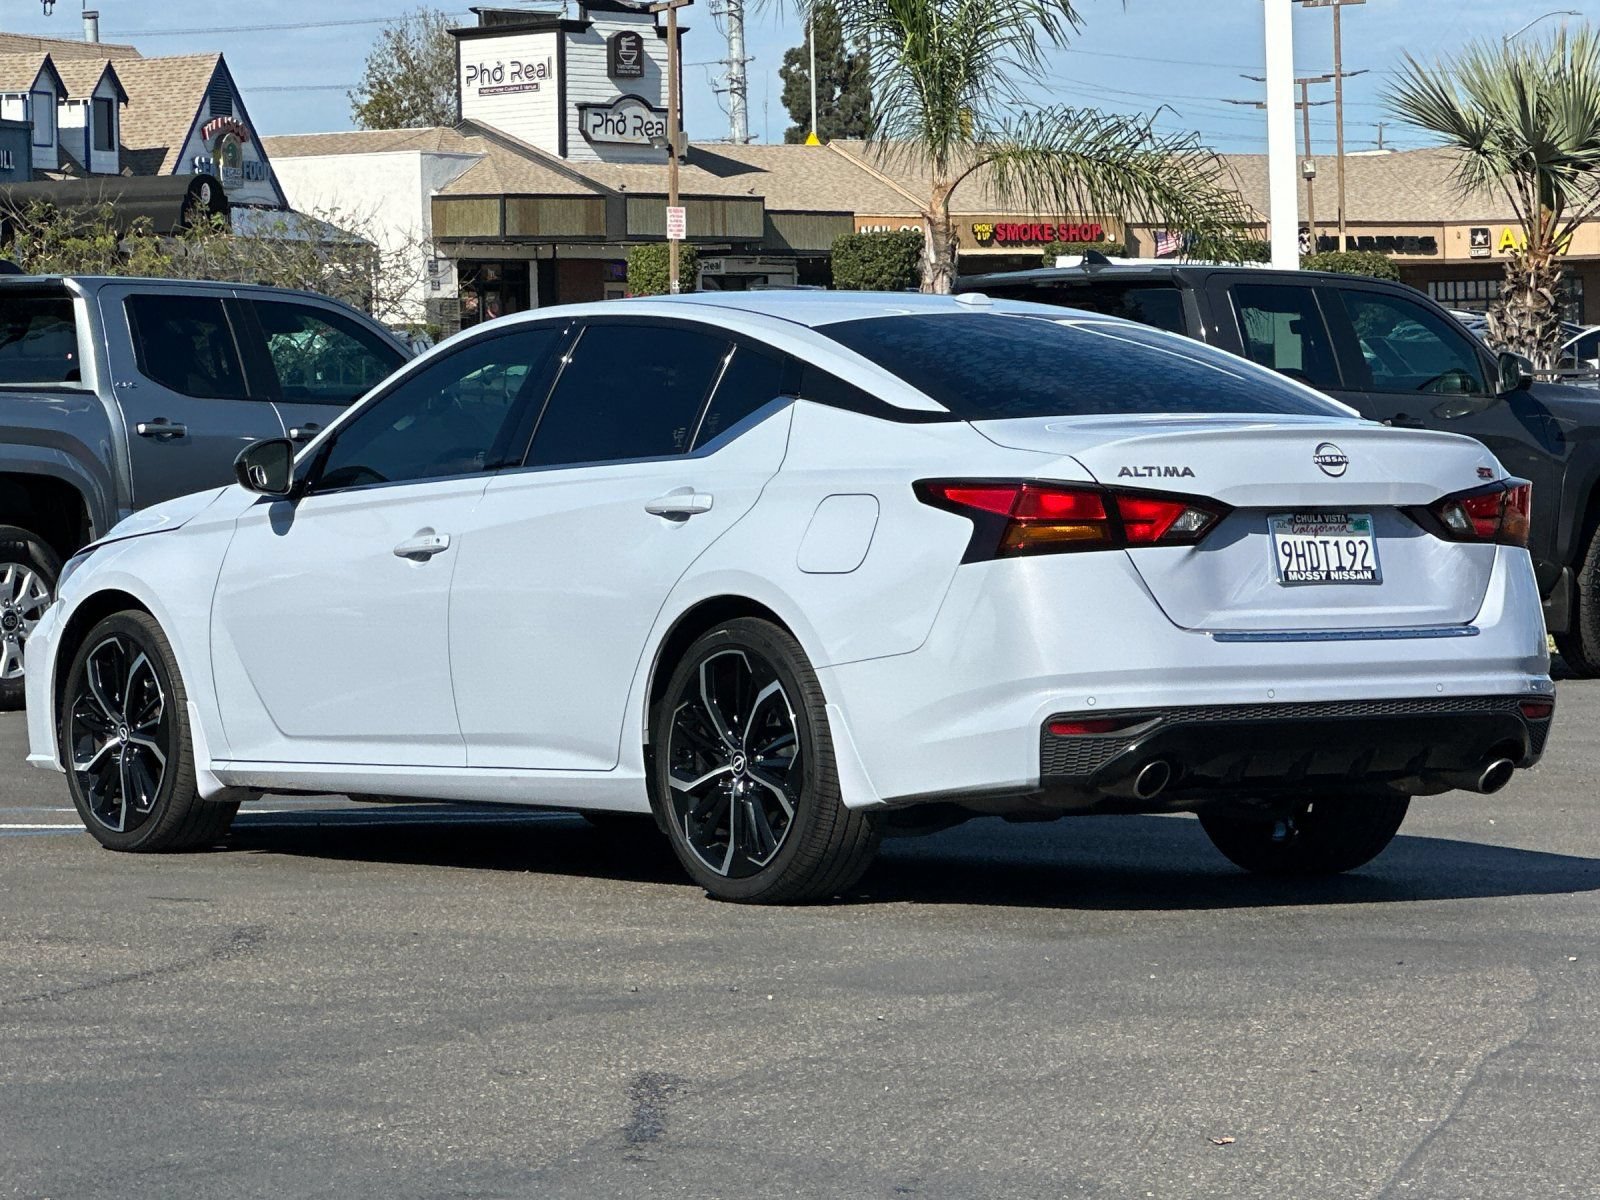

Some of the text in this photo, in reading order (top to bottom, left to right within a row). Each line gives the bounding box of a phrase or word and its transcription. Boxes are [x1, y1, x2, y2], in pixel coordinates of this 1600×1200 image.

[510, 56, 552, 82] Real
[633, 115, 668, 137] Real
[974, 224, 993, 232] SMOKE
[995, 223, 1102, 241] SMOKE SHOP
[1313, 455, 1348, 464] NISSAN
[1118, 466, 1196, 478] ALTIMA
[1295, 514, 1347, 523] CHULA VISTA
[1281, 540, 1372, 571] 9HDT192
[1288, 571, 1372, 580] MOSSY NISSAN
